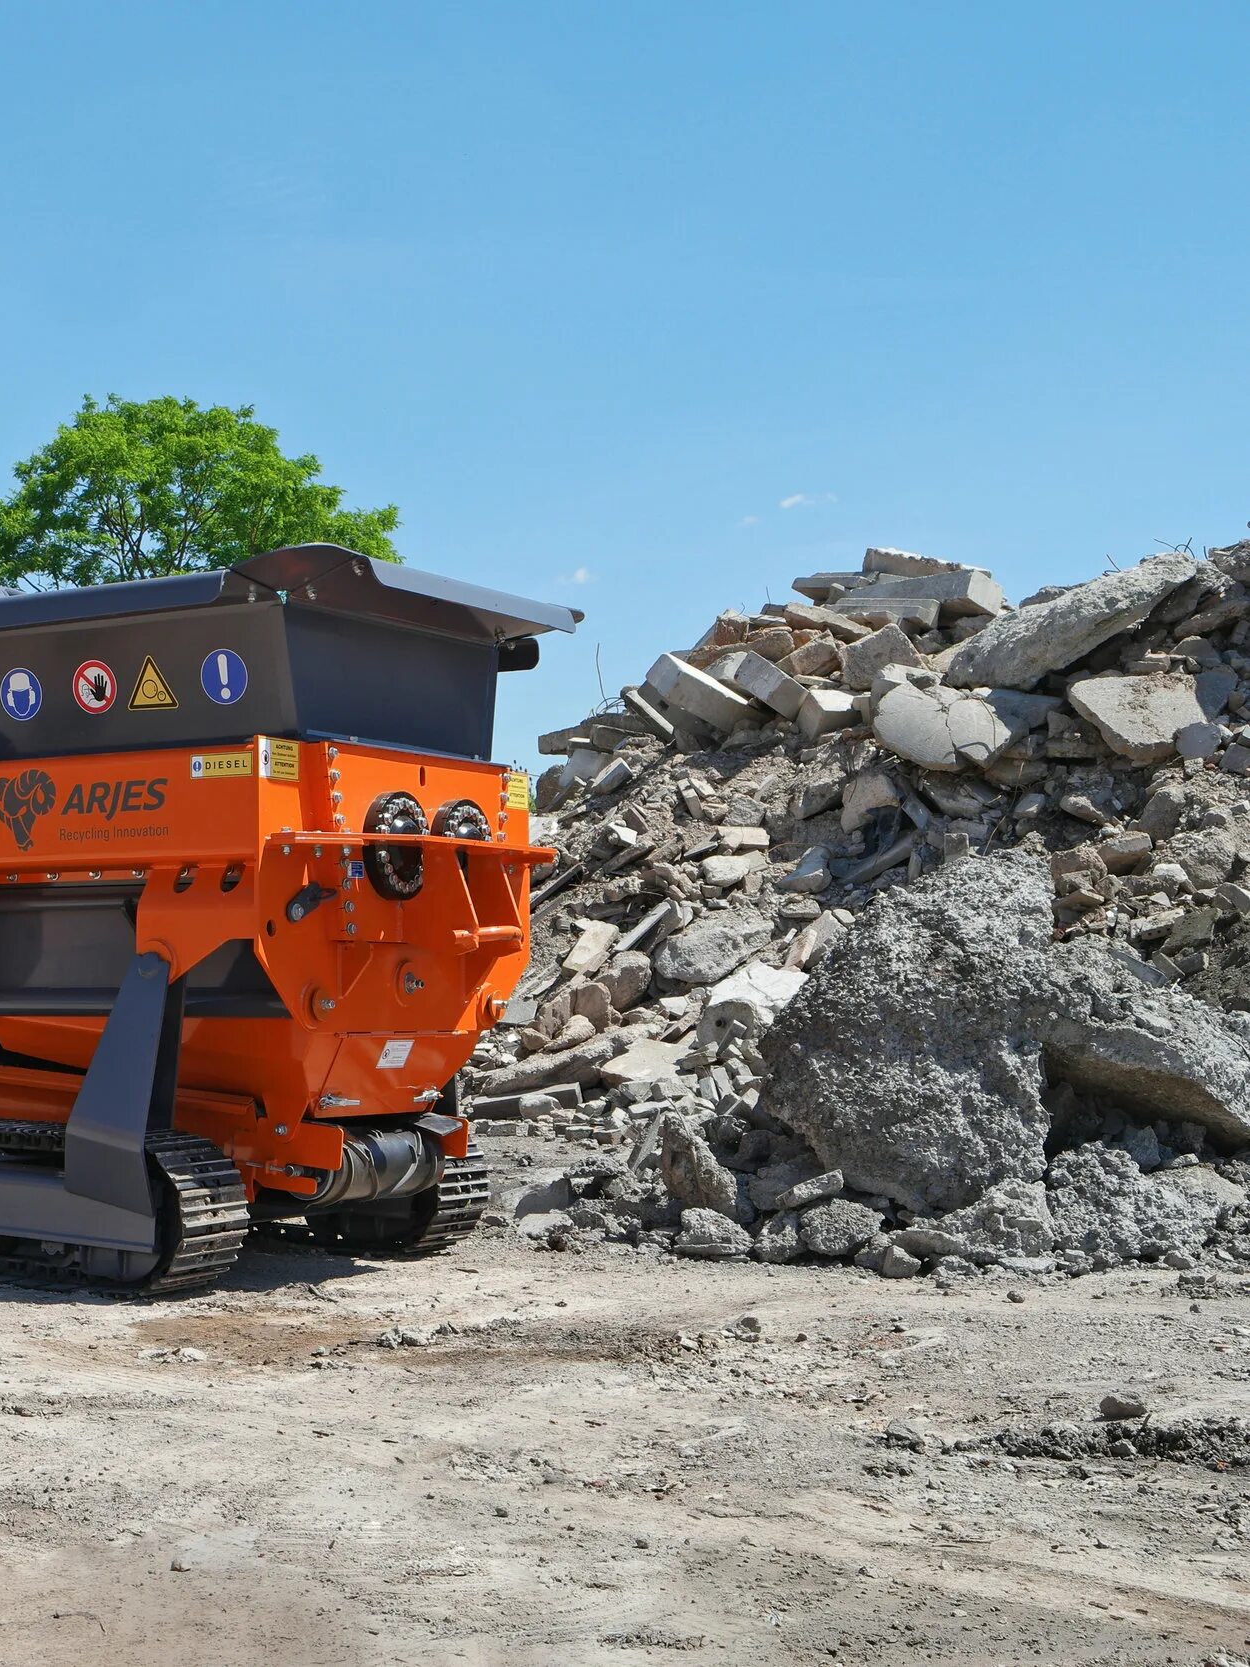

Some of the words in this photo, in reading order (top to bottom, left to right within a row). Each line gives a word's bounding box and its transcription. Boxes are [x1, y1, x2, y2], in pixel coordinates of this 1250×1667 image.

[205, 760, 247, 770] DIESEL
[61, 778, 168, 821] ARJES
[59, 827, 110, 842] Recycling
[113, 824, 169, 838] Innovation
